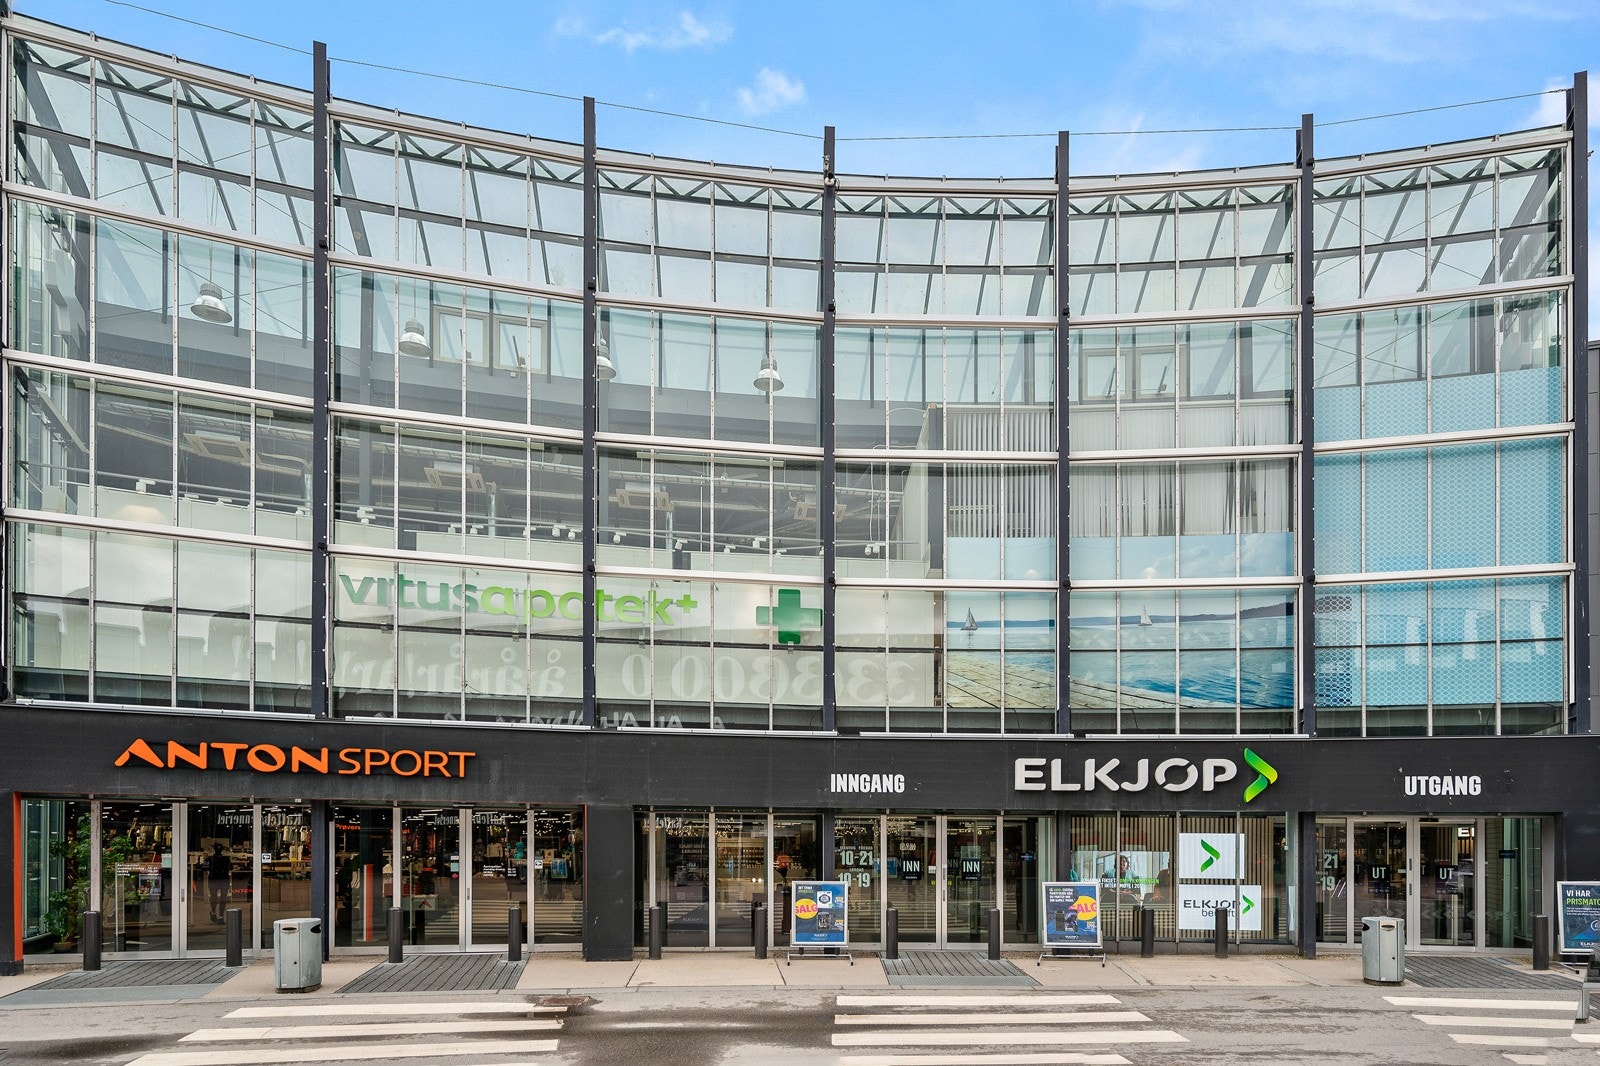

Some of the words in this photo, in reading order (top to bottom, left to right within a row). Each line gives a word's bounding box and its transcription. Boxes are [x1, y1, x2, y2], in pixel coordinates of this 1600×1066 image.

[114, 738, 328, 774] ANTON
[338, 747, 476, 778] SPORT
[830, 773, 905, 793] INNGANG
[1404, 775, 1482, 796] UTGANG
[902, 860, 920, 872] INN
[962, 861, 980, 873] INN
[1372, 867, 1387, 879] UT
[1439, 868, 1454, 880] UT
[1566, 889, 1574, 897] VI
[1575, 889, 1591, 897] HAR
